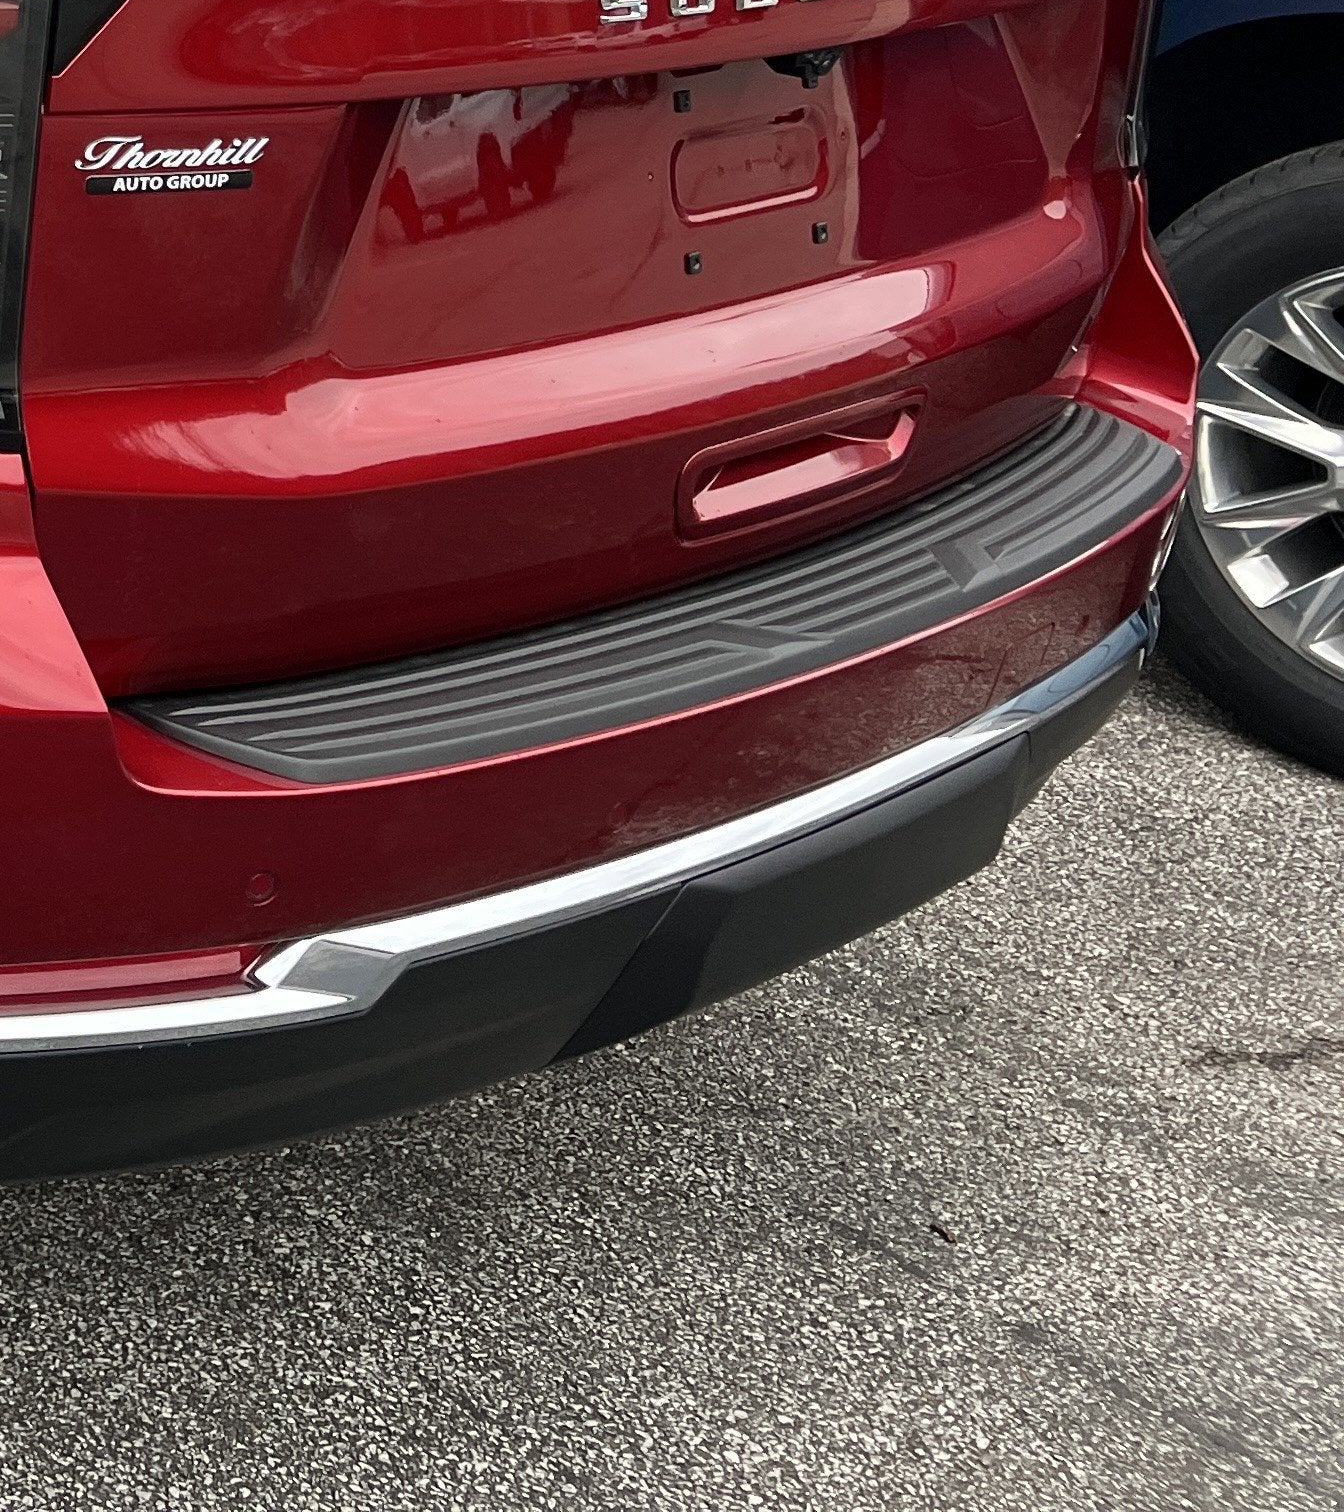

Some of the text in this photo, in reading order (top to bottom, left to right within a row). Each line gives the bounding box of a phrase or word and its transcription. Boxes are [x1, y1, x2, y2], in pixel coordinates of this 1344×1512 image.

[74, 135, 269, 170] Thornhill
[113, 173, 229, 192] AUTO GROUP
